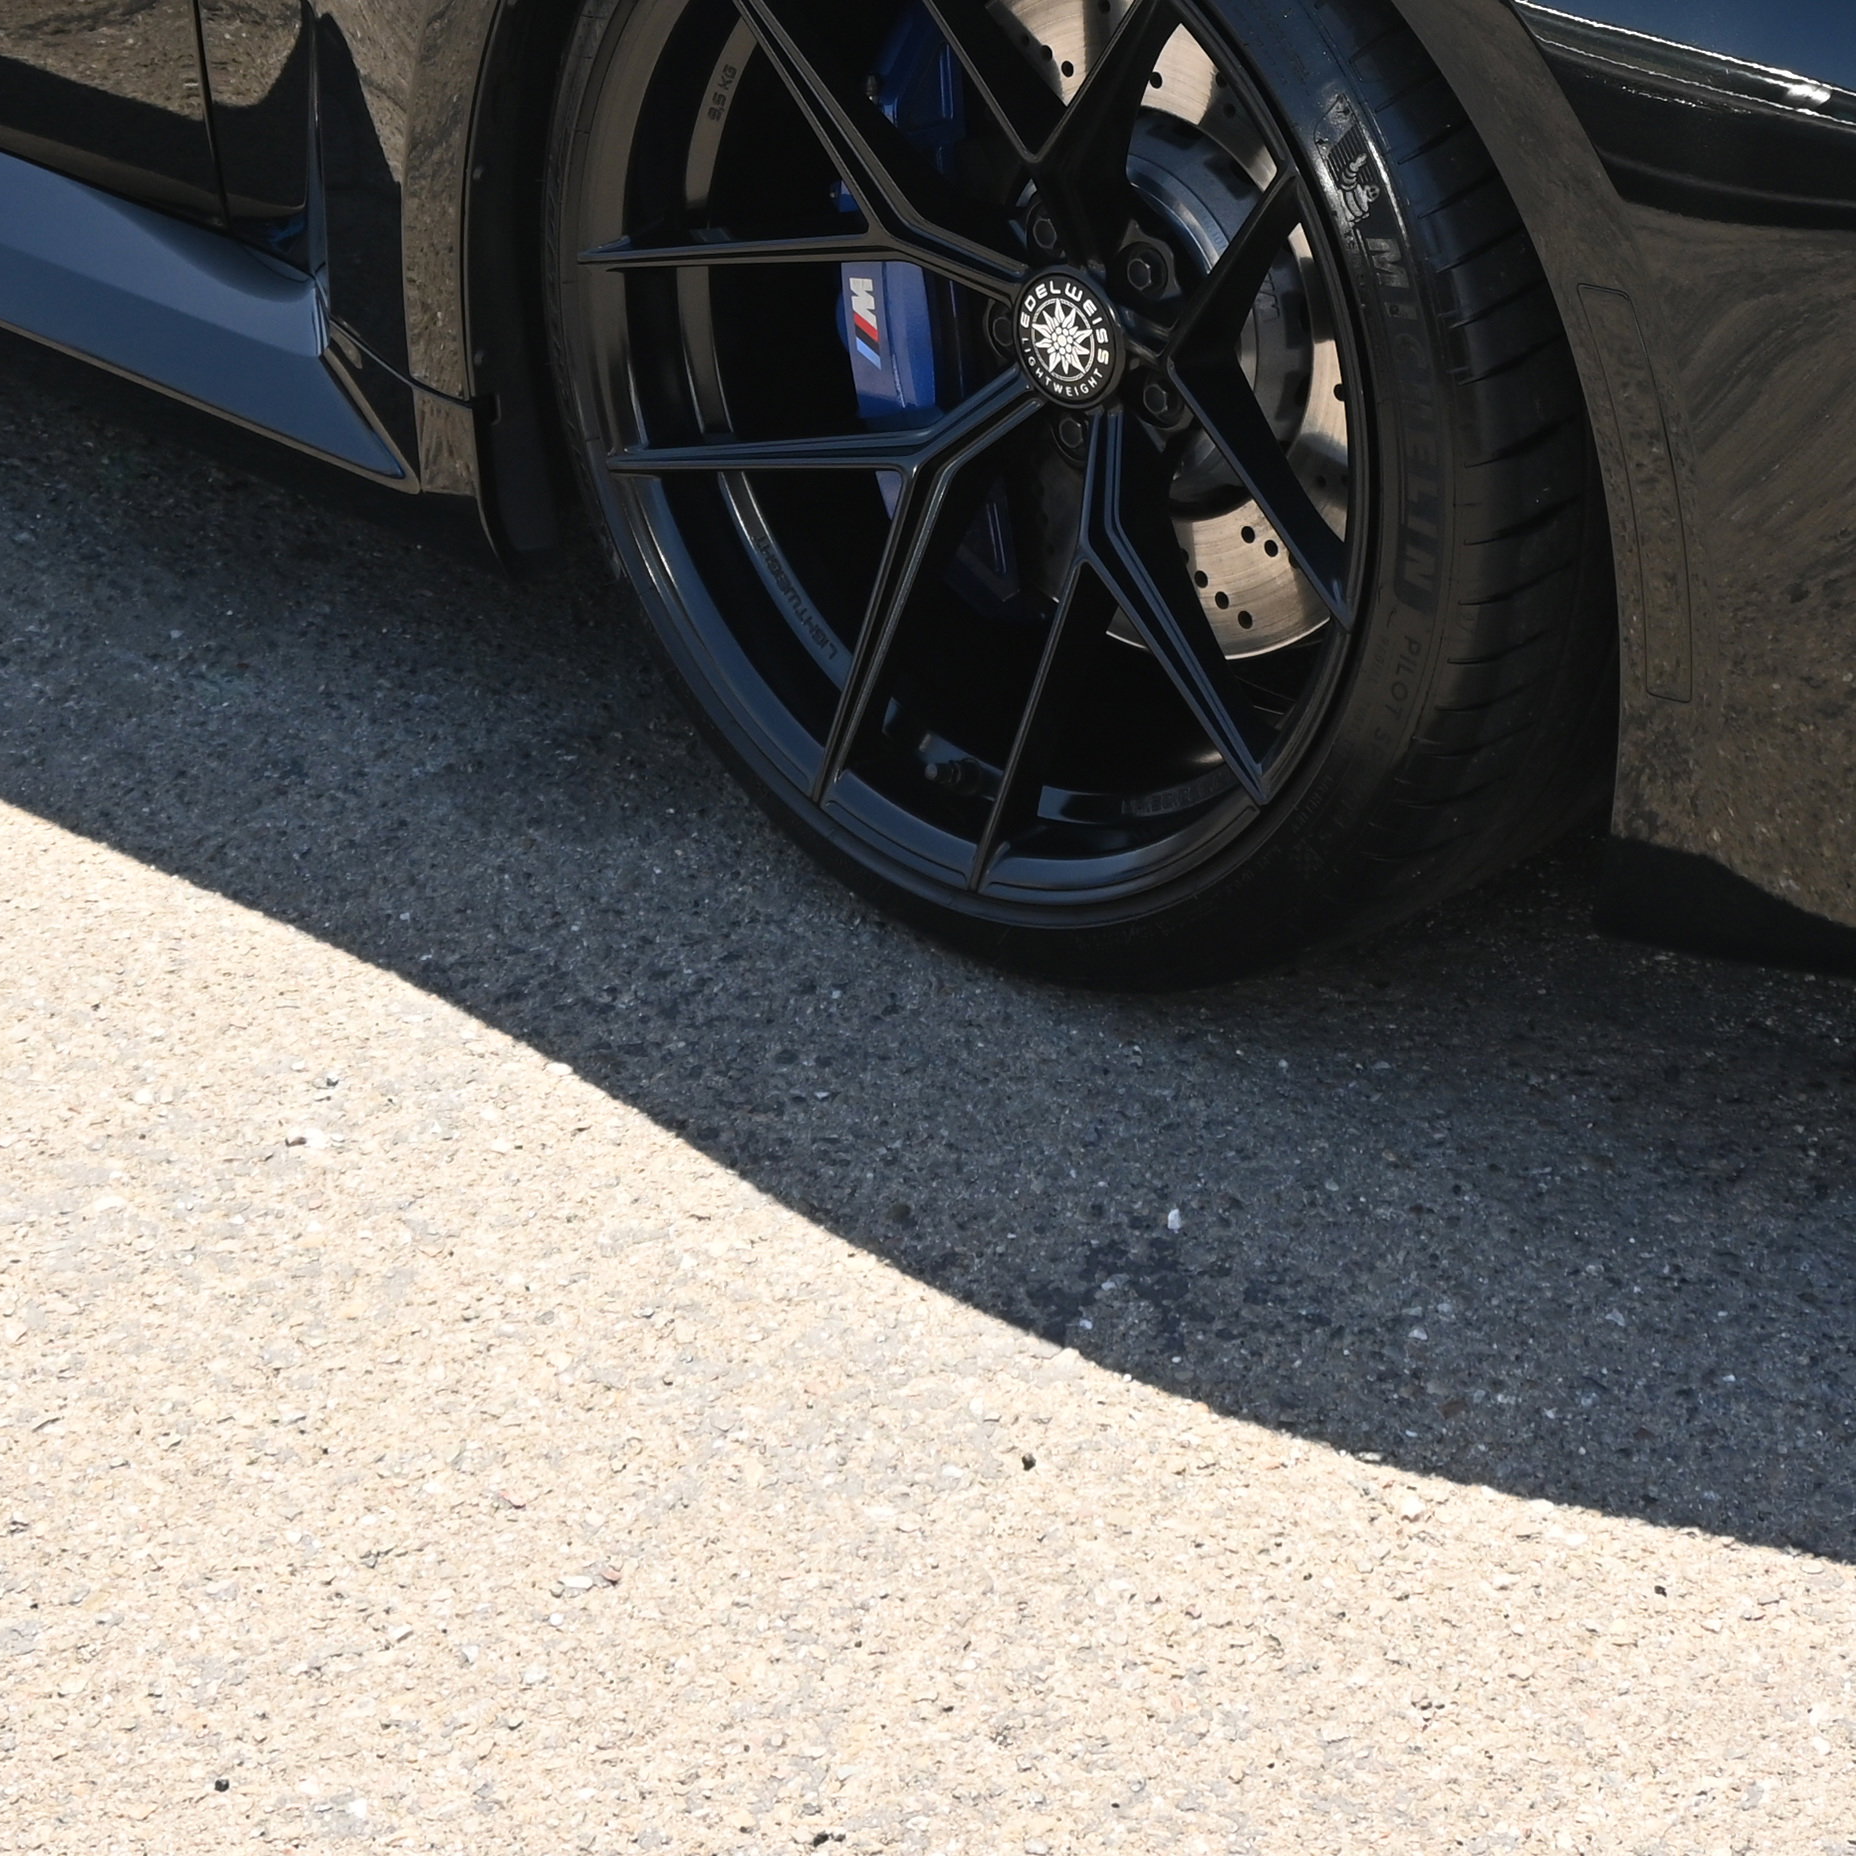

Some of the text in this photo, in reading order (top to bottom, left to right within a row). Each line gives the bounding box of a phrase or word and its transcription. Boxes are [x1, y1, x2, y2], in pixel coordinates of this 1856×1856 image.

[717, 63, 738, 91] KG
[1019, 279, 1110, 366] EDELWEISS
[1020, 335, 1105, 400] LIGHTWEIGHT
[1366, 236, 1441, 596] MICHELIN
[753, 535, 839, 661] LIGHTWEIGHT
[1383, 634, 1423, 722] PILOT
